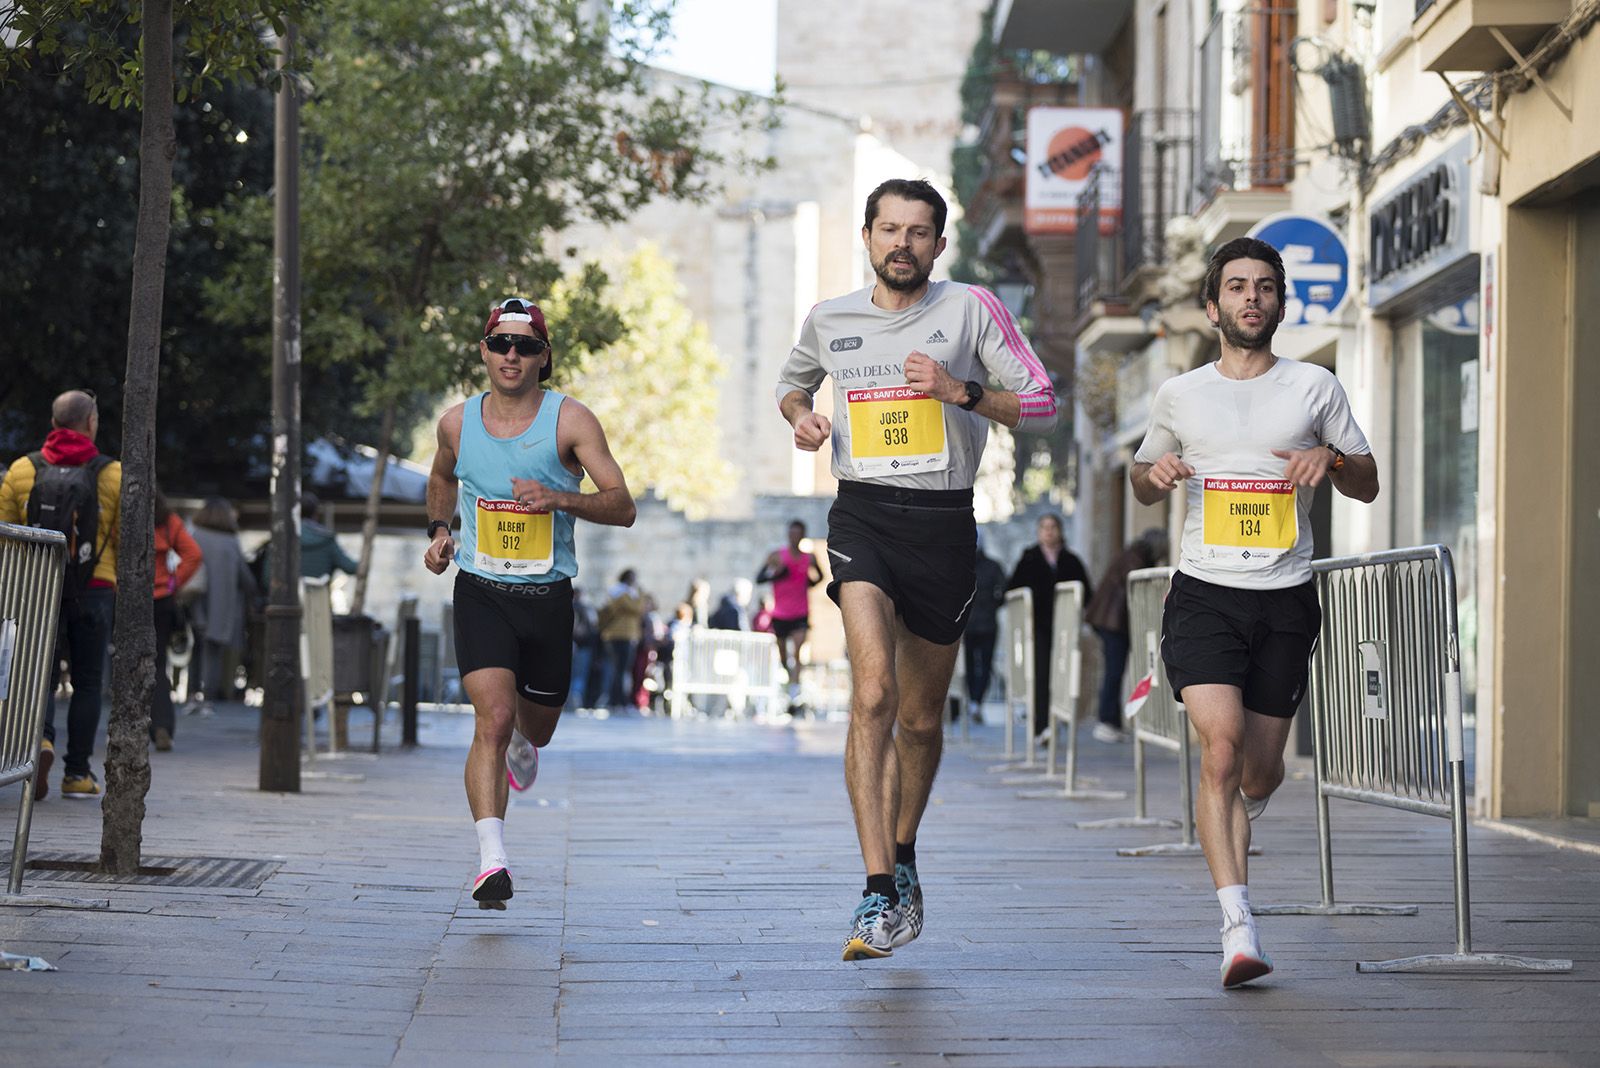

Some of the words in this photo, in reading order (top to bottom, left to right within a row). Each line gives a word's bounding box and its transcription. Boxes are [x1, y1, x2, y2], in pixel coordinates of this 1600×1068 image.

[843, 341, 857, 349] BCN
[831, 366, 861, 380] CURSA
[863, 364, 891, 377] DELS
[849, 393, 871, 401] MITJA
[873, 390, 895, 399] SANT
[879, 410, 909, 425] JOSEP
[884, 427, 908, 446] 938
[1207, 481, 1229, 489] MITJA
[1231, 482, 1255, 490] SANT
[1254, 482, 1283, 490] CUGAT
[1283, 482, 1293, 490] 22
[496, 502, 515, 510] SANT
[1230, 503, 1270, 517] ENRIQUE
[497, 521, 526, 533] ALBERT
[1239, 519, 1261, 536] 134
[502, 535, 520, 550] 912
[509, 584, 550, 595] PRO
